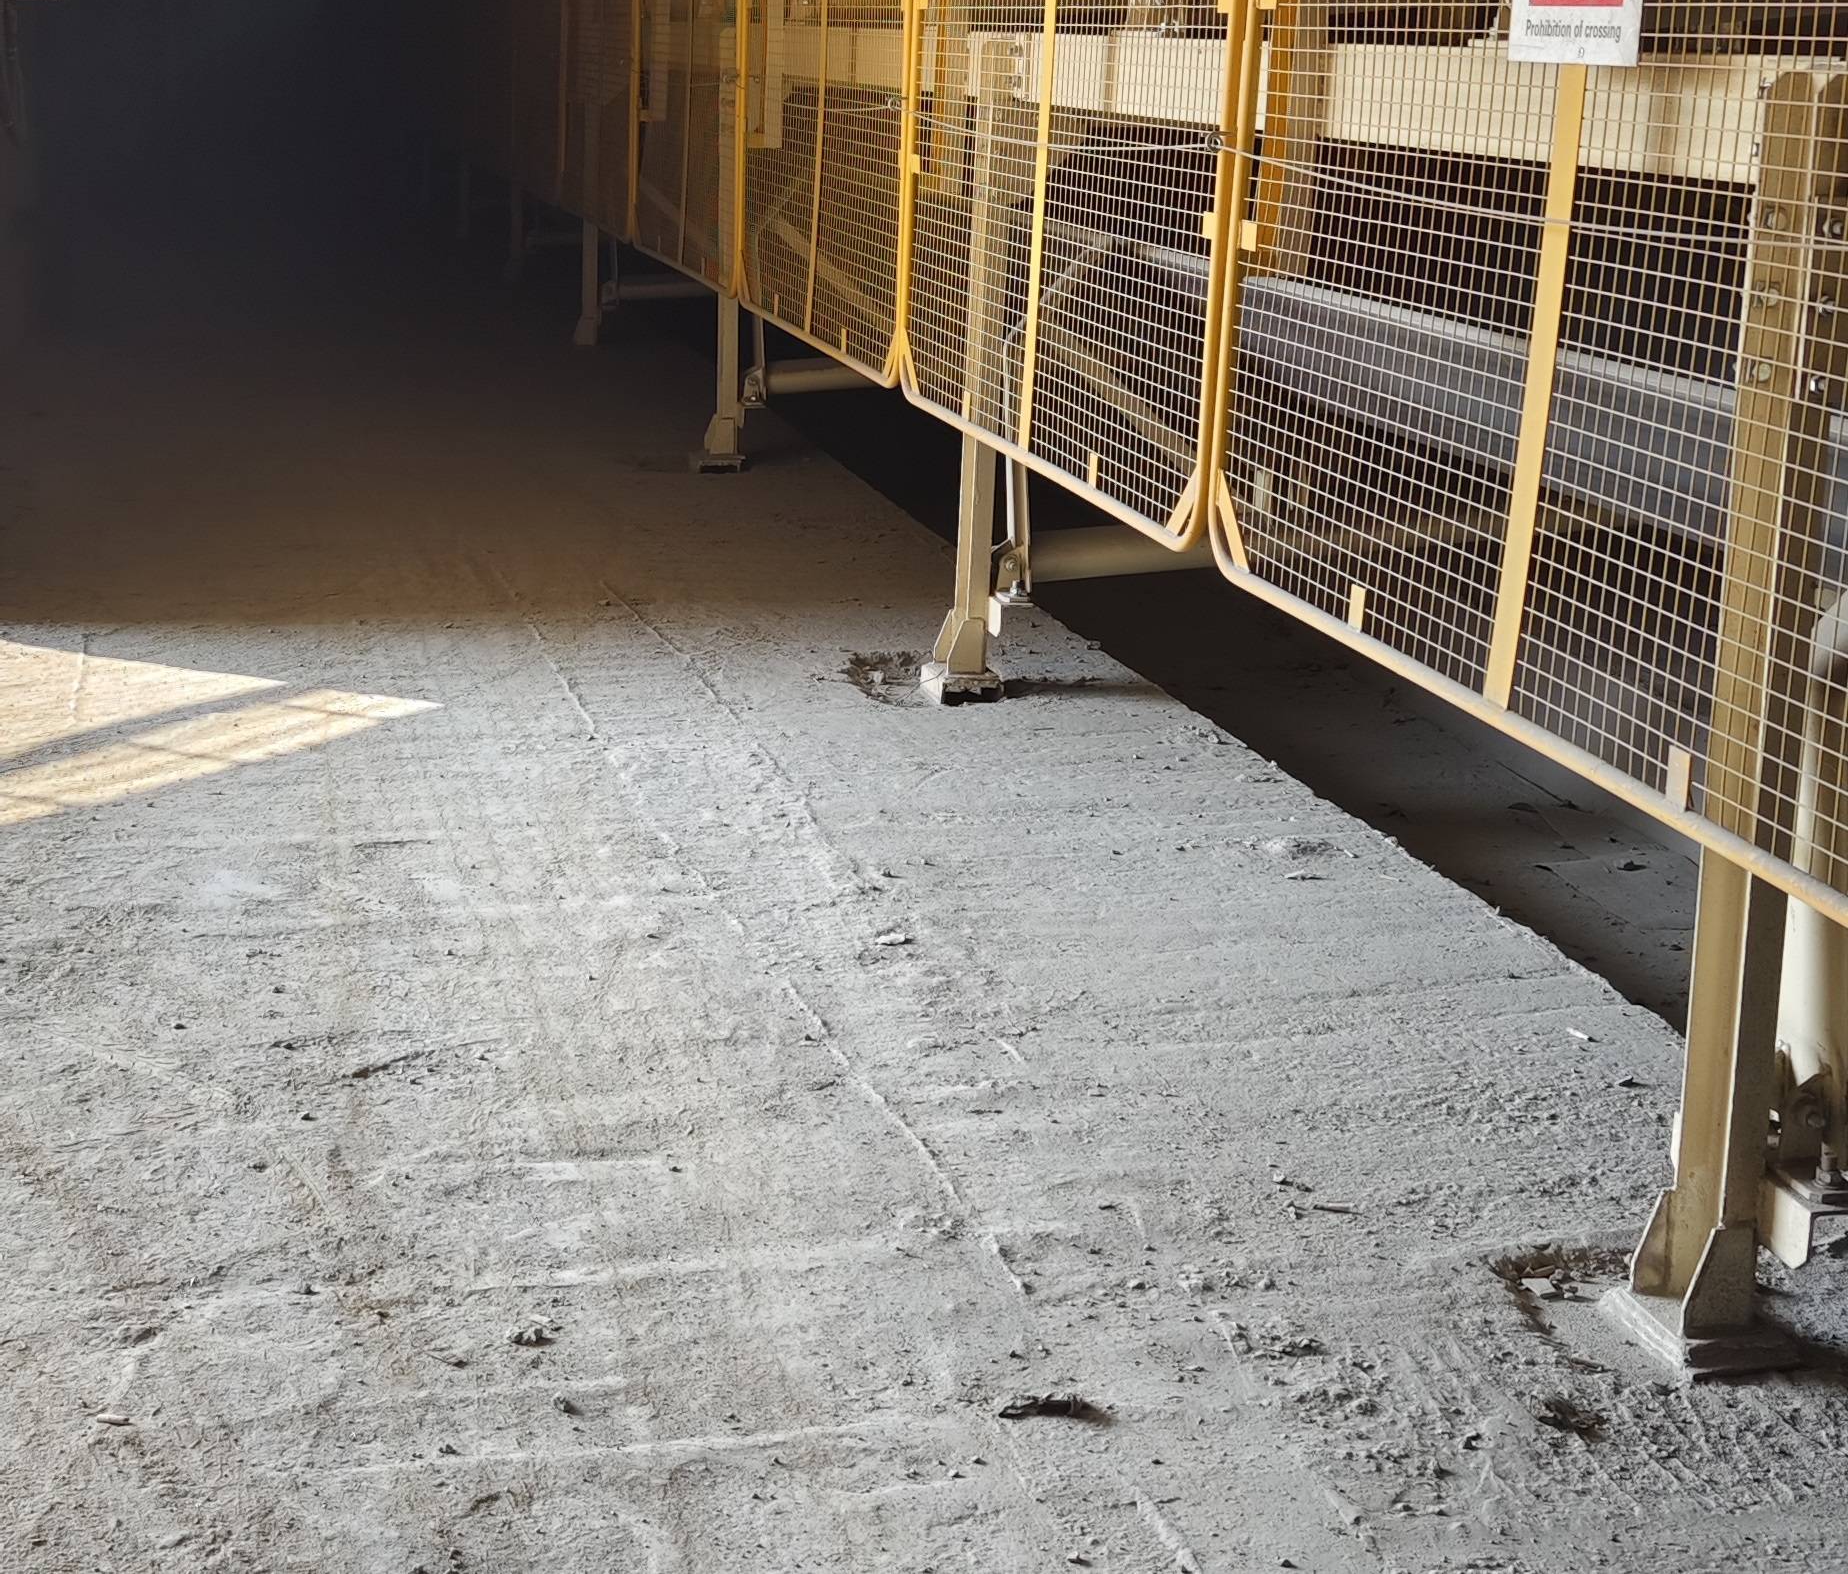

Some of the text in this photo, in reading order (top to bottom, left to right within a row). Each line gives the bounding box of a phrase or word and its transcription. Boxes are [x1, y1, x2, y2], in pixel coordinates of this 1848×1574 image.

[1525, 19, 1621, 43] Prohibition of crossing
